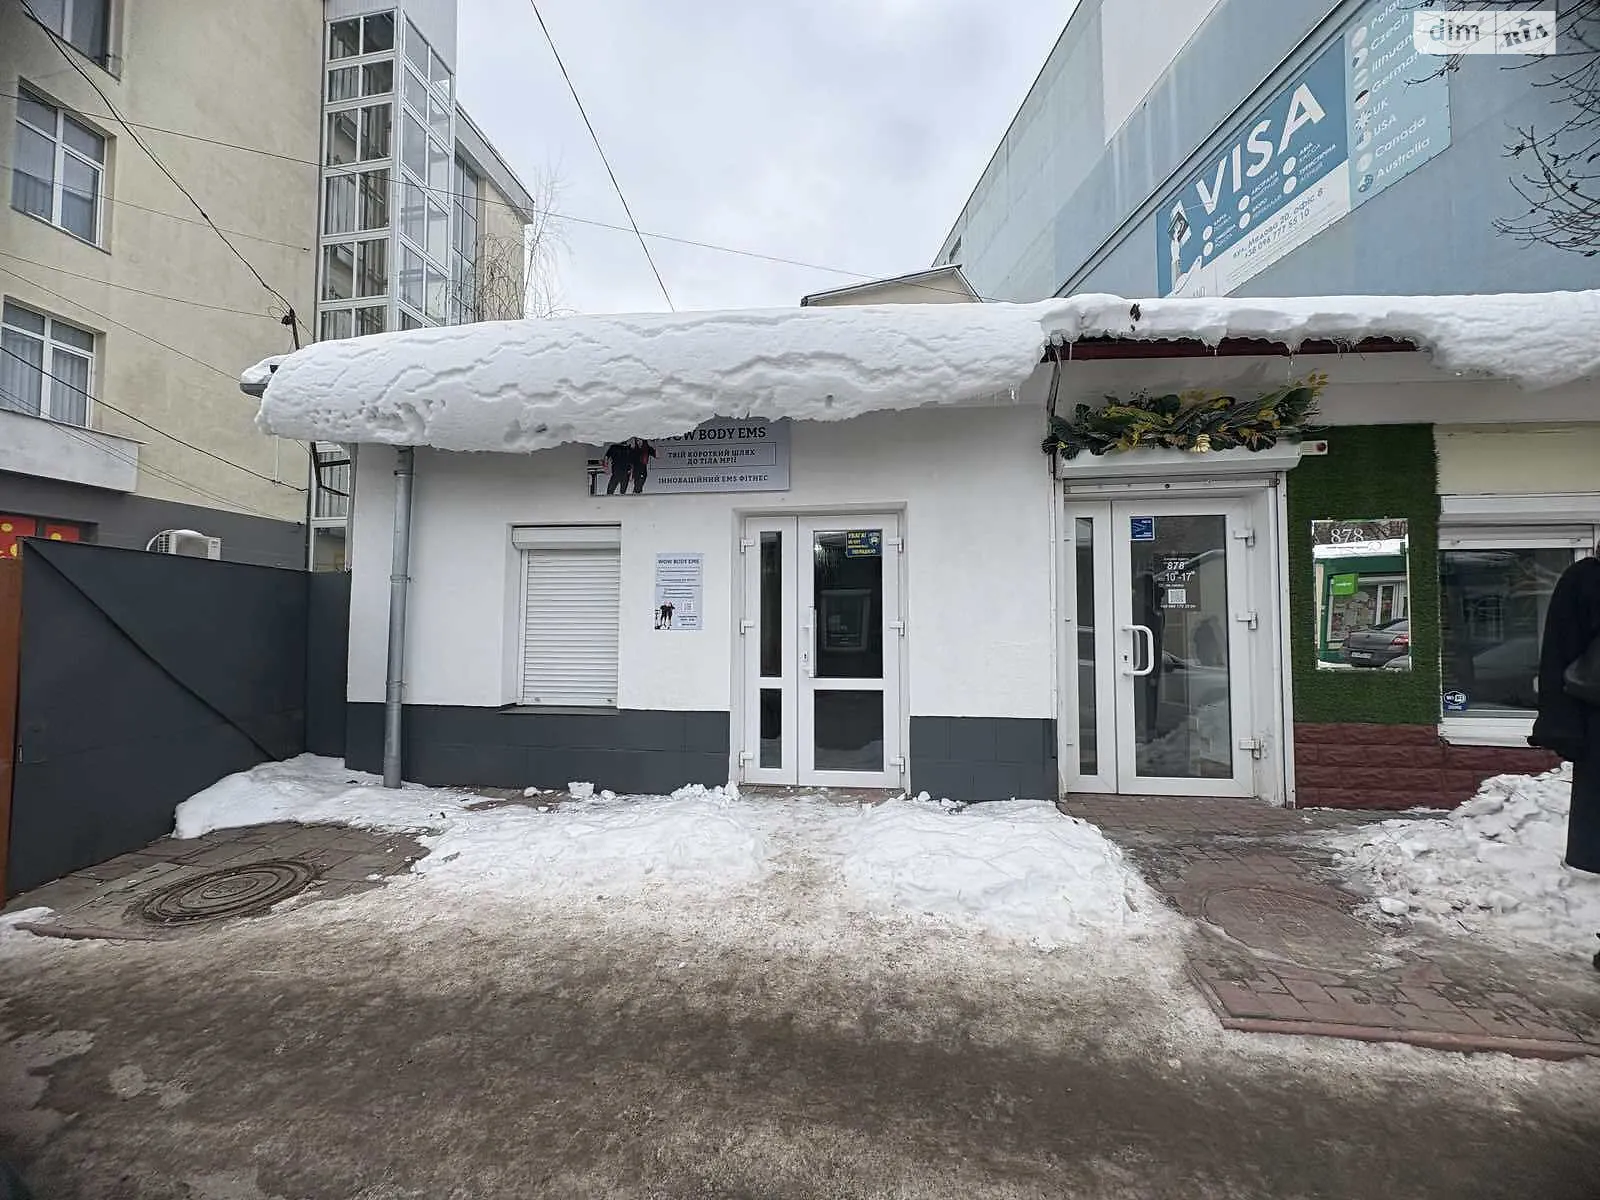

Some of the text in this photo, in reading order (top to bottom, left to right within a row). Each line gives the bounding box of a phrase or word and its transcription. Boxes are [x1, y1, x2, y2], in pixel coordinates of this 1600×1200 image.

[1374, 114, 1396, 137] USA
[1375, 117, 1426, 157] Canada
[1195, 82, 1326, 216] VISA
[1376, 138, 1430, 177] Australia
[698, 428, 735, 441] BODY
[738, 427, 766, 438] EMS
[687, 449, 728, 458] КОРОТКИЙ
[731, 448, 756, 457] ШЛЯХ
[686, 458, 699, 466] ДО
[700, 457, 719, 465] ТІЛА
[658, 474, 768, 484] ІННОВАЦІЙНИЙ EMS ФІТНЕС
[1330, 527, 1365, 544] 878
[1166, 561, 1185, 571] 878
